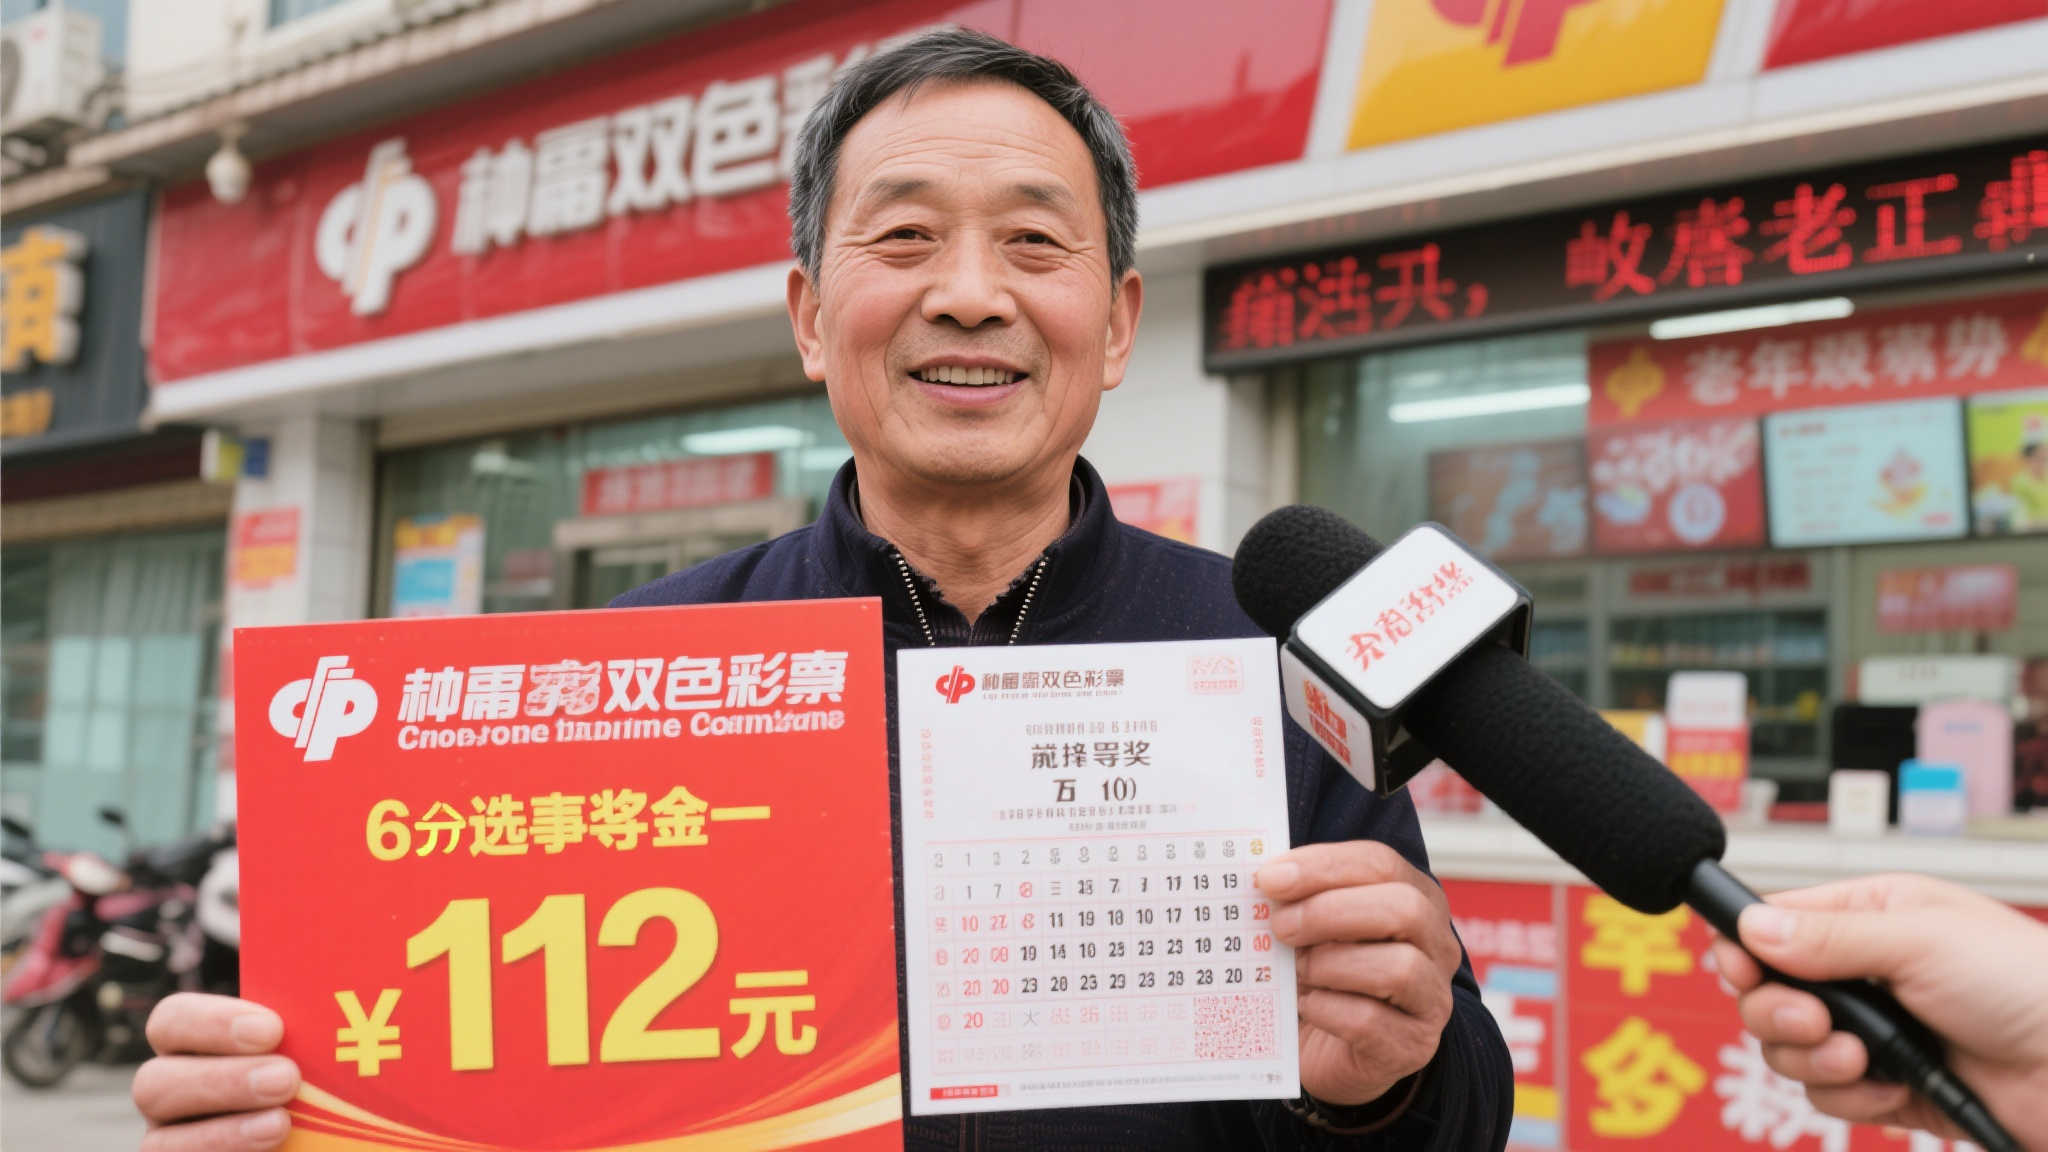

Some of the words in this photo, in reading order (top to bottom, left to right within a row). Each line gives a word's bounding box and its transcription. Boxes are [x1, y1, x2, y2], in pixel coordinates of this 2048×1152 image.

[365, 786, 771, 862] 6分选事奖金一
[1050, 912, 1064, 929] 11
[1166, 907, 1182, 923] 17
